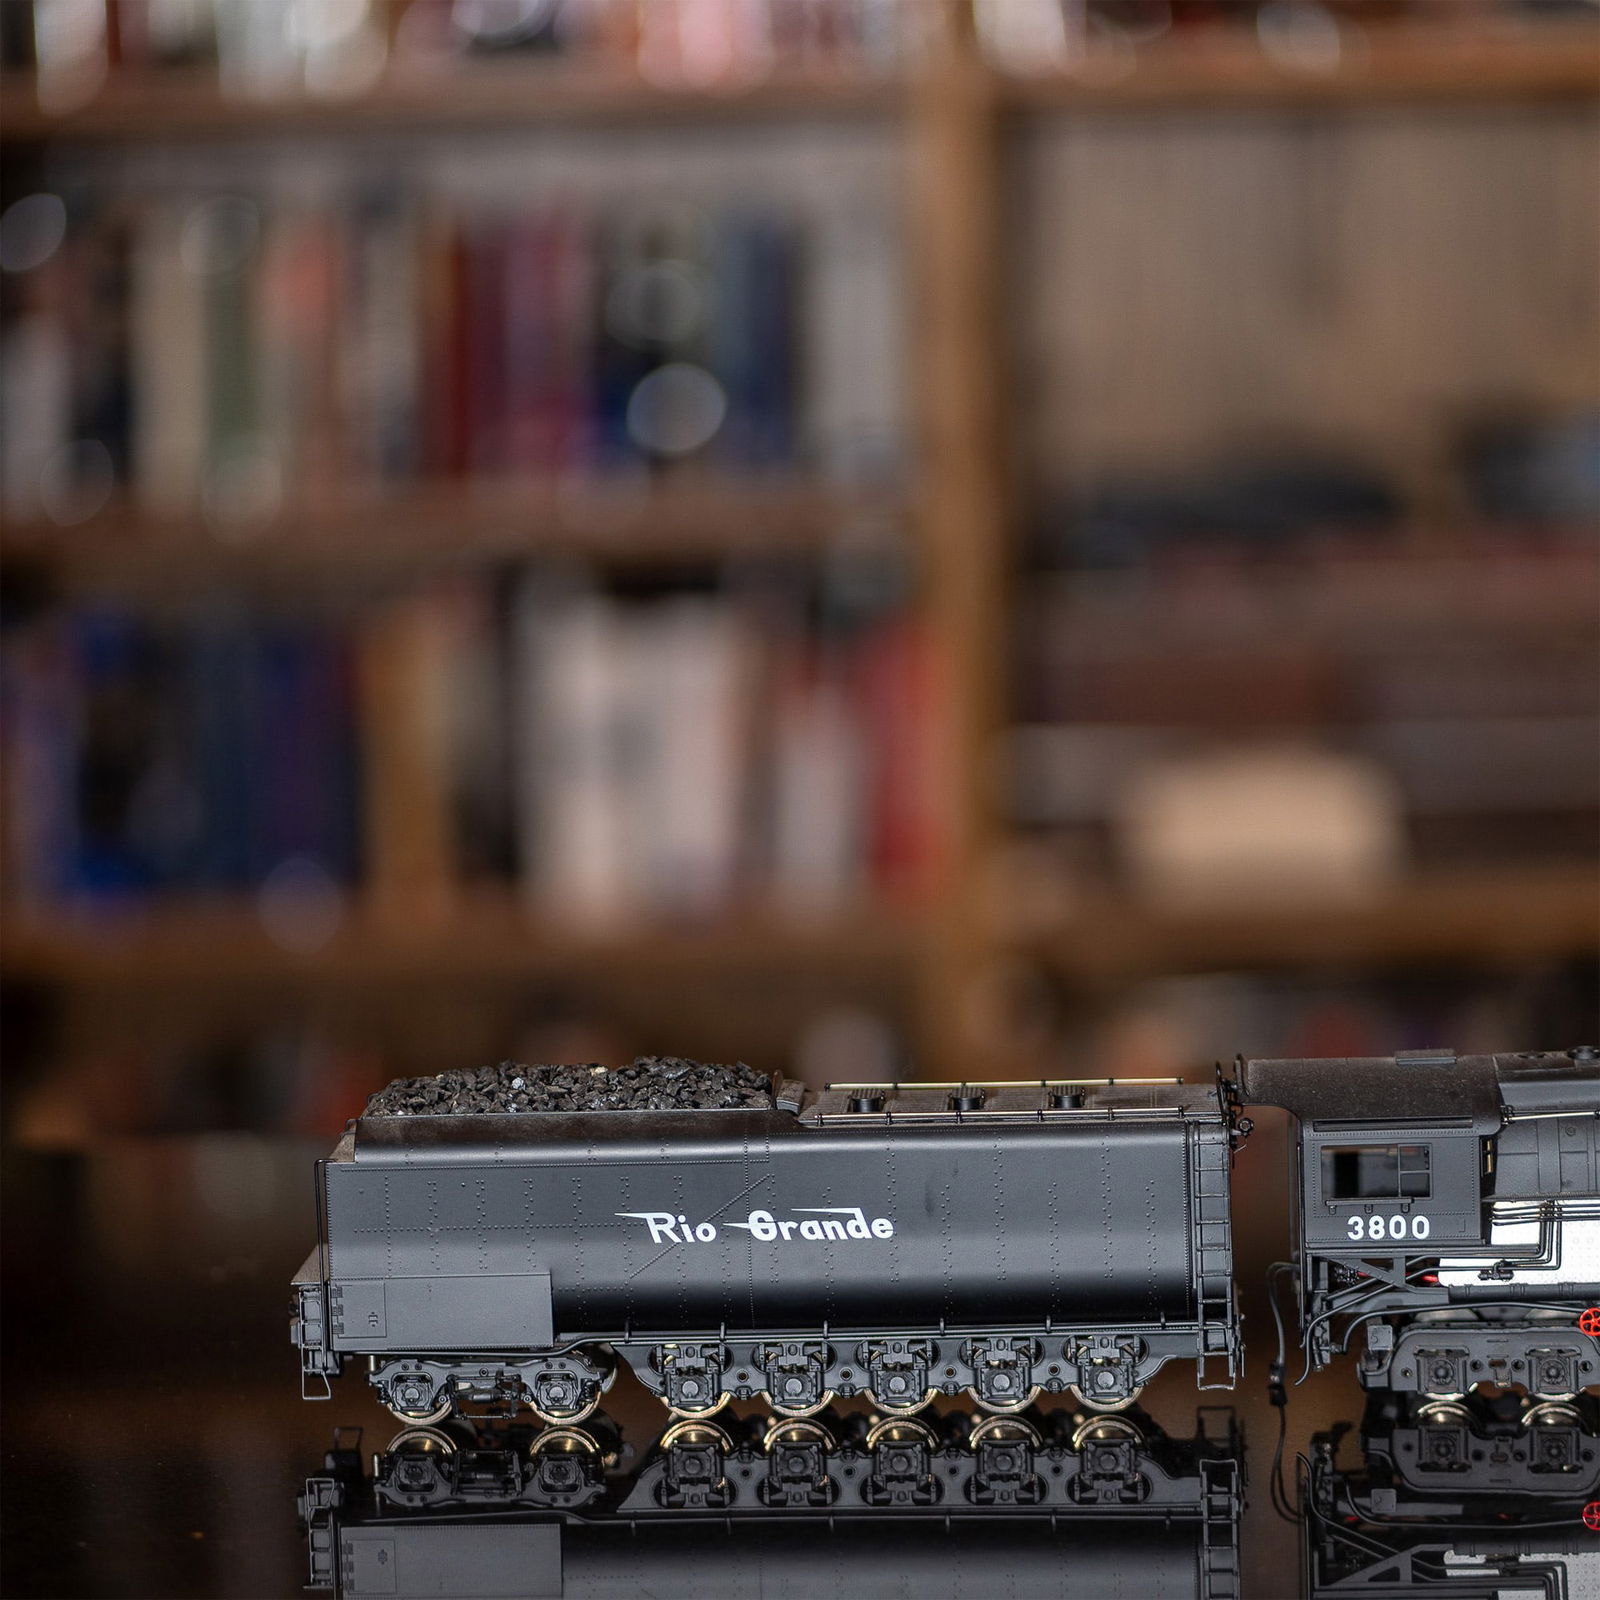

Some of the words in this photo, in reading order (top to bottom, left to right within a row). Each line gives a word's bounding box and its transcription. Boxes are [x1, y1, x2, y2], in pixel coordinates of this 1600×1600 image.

[614, 1212, 717, 1244] Rio
[722, 1207, 894, 1242] Grande
[1347, 1215, 1430, 1240] 3800
